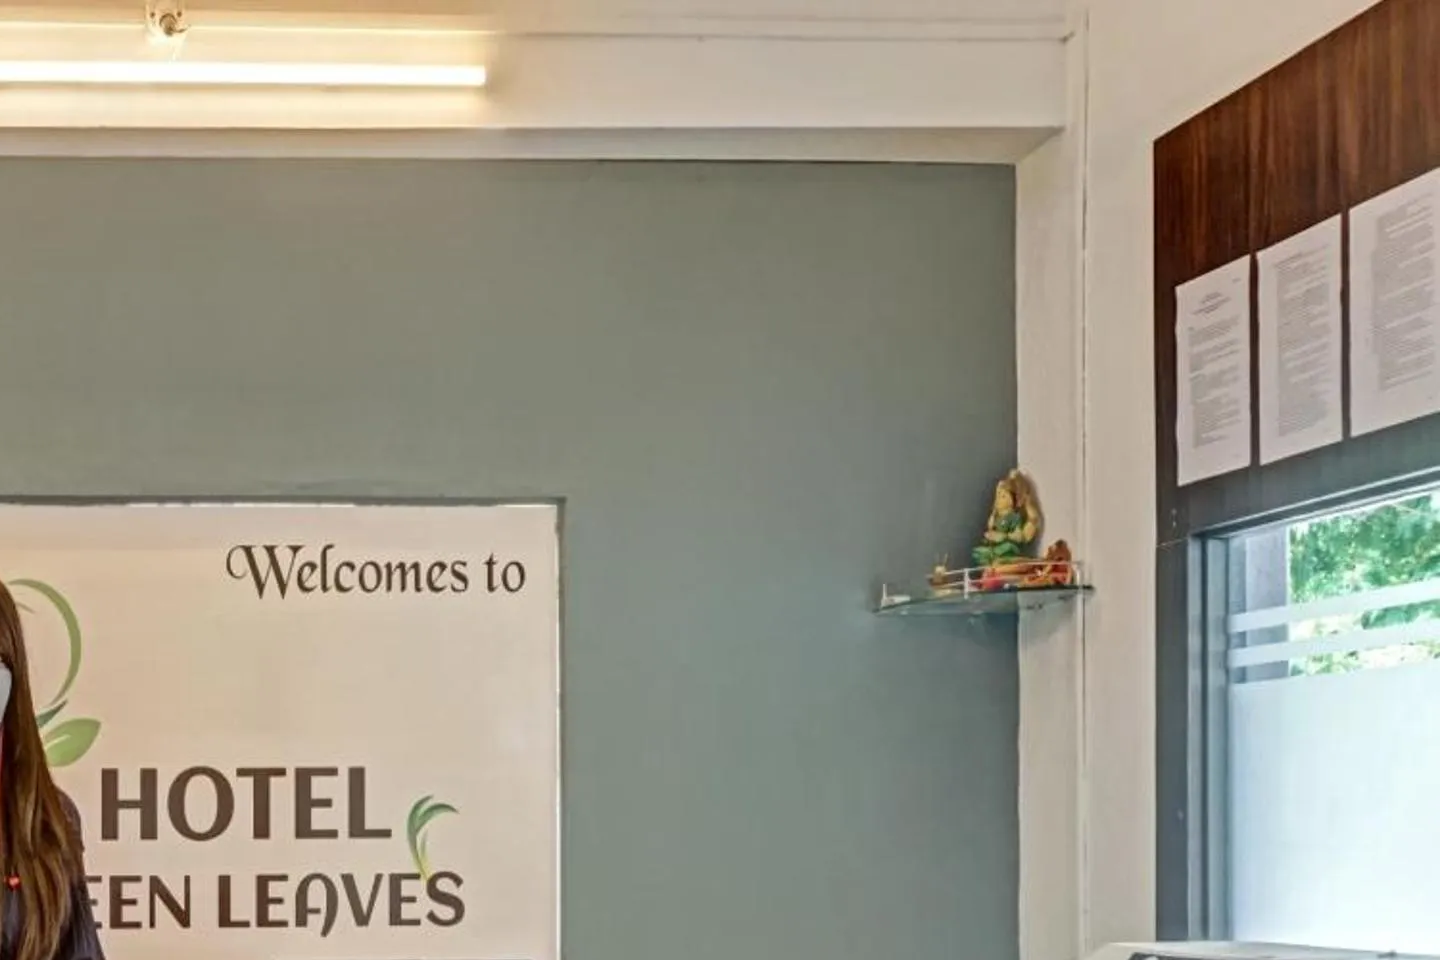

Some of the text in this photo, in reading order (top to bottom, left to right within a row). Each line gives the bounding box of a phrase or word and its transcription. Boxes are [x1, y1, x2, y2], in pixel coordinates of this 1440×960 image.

[226, 544, 526, 600] Welcomes to
[100, 766, 392, 841] HOTEL
[217, 871, 466, 938] LEAVES
